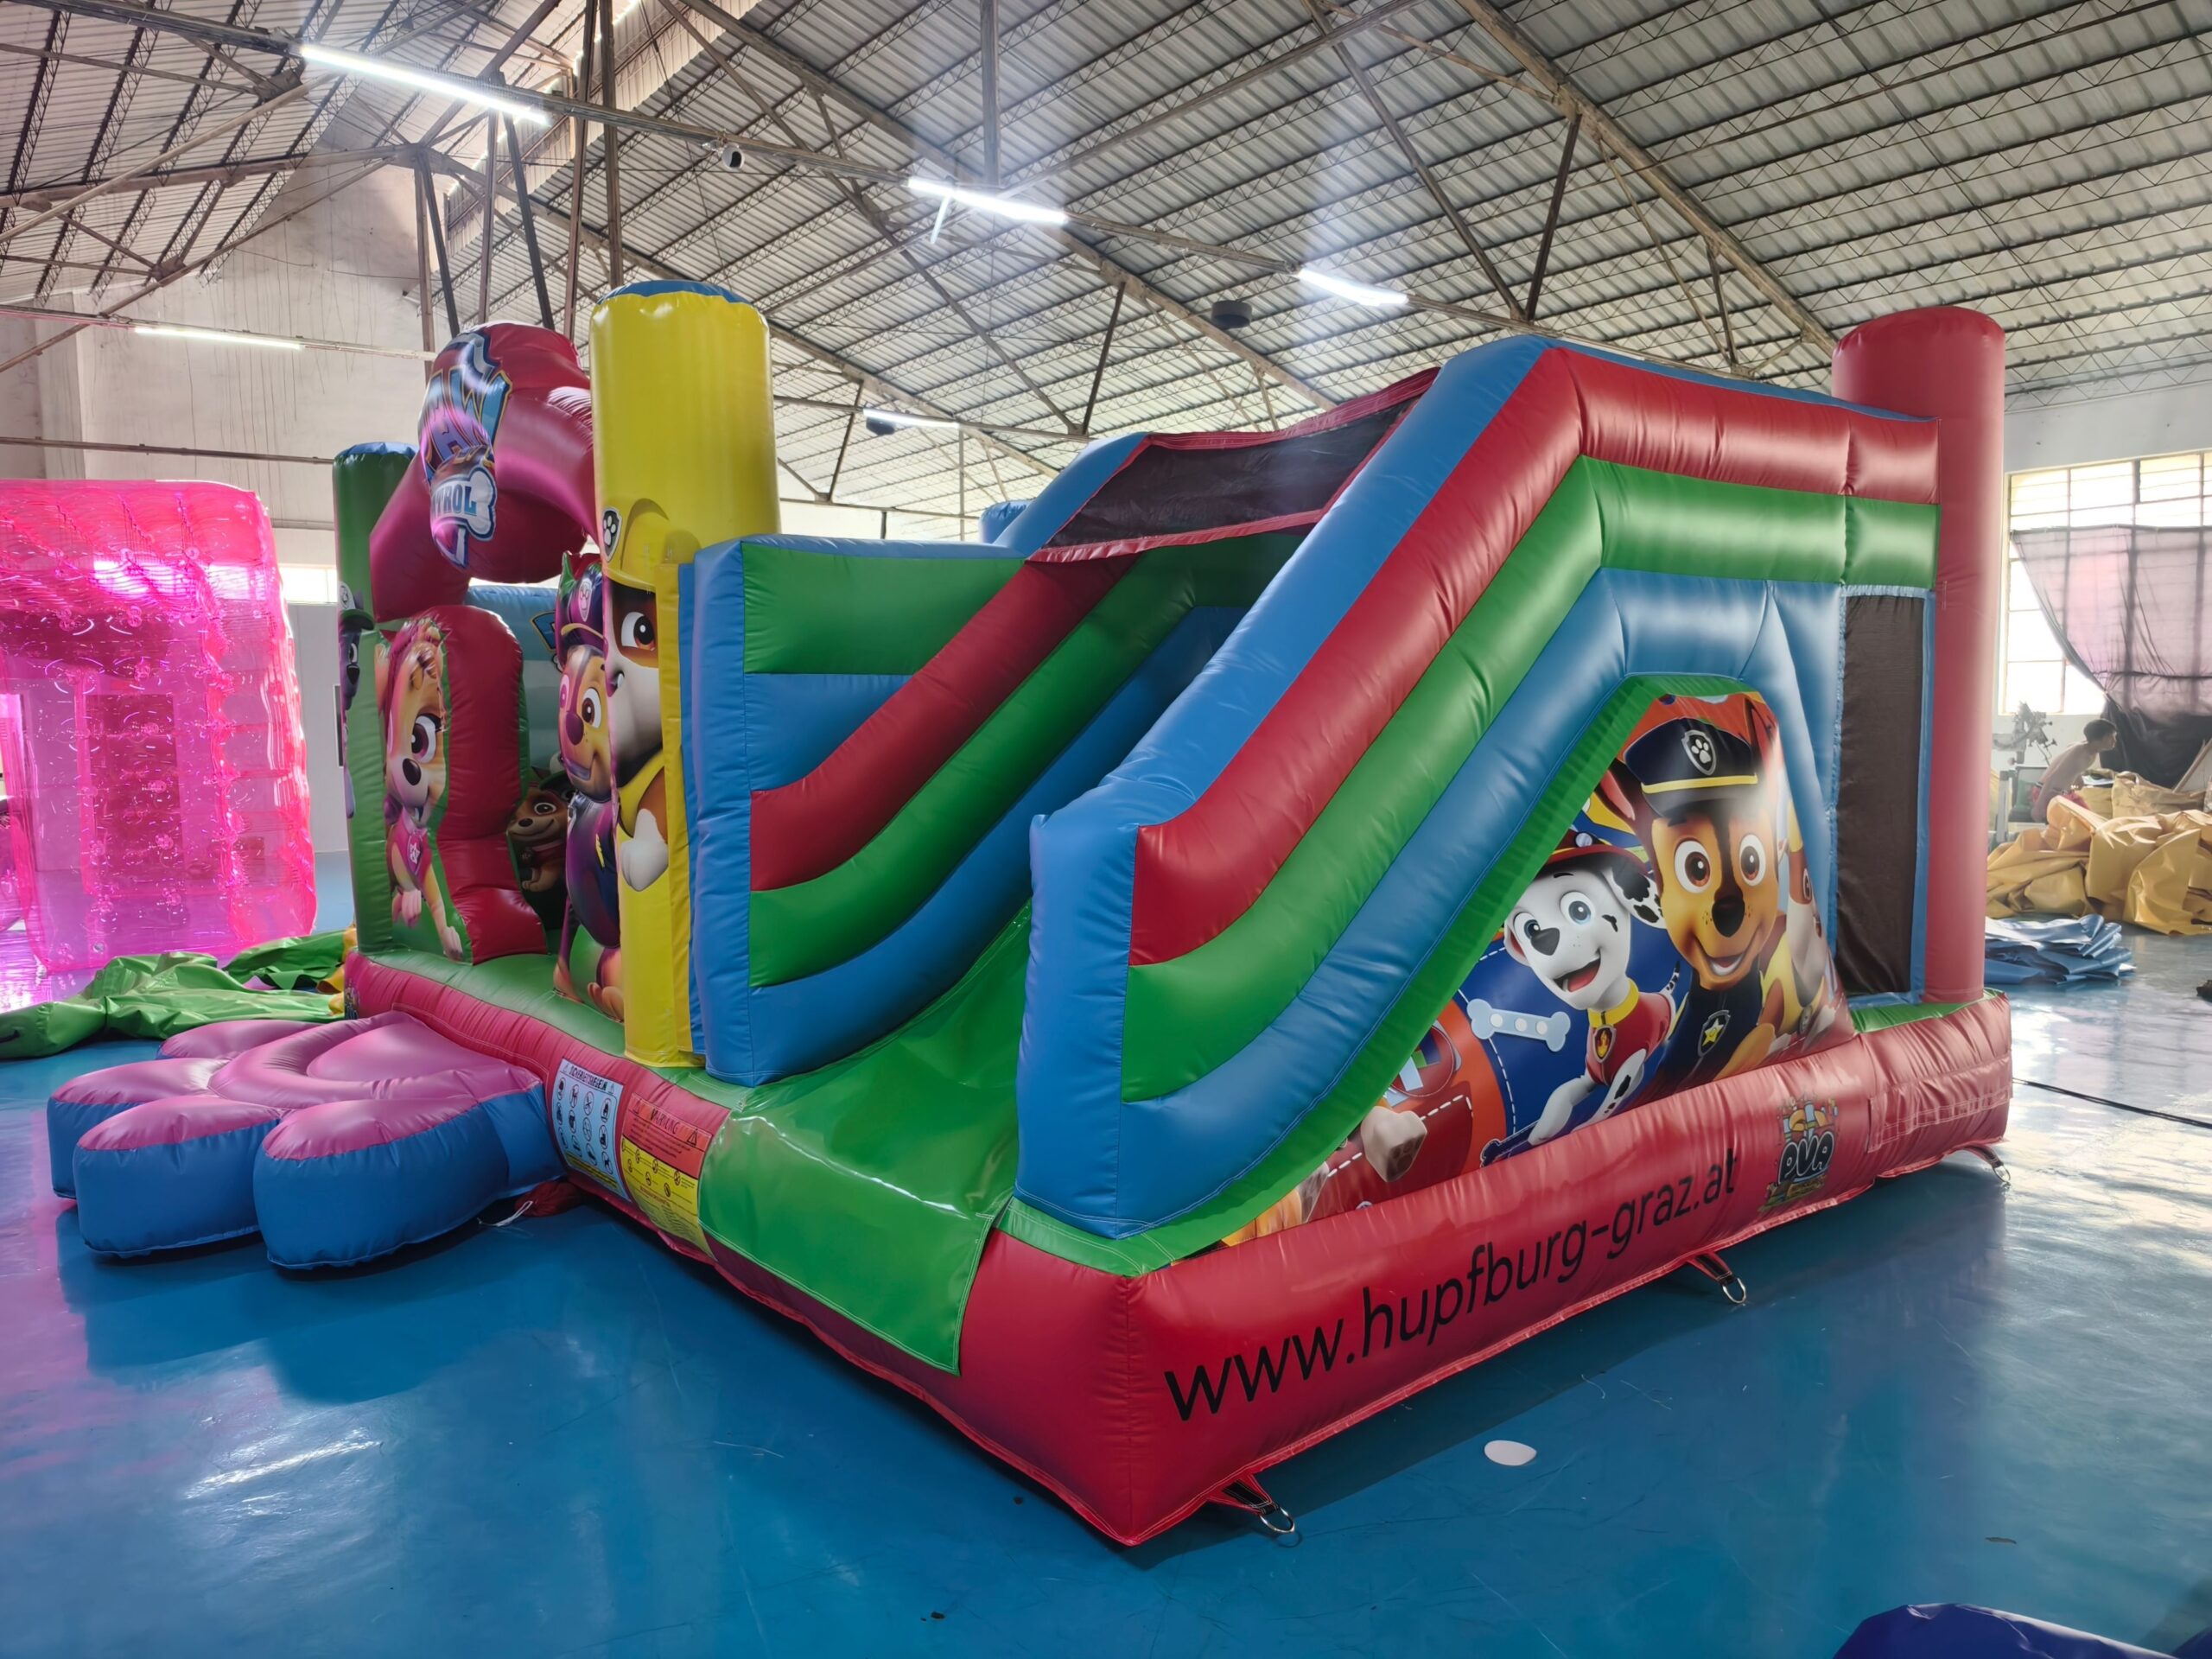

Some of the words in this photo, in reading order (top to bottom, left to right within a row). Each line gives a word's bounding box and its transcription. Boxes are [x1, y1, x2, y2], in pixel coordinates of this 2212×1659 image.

[418, 369, 512, 478] AW
[1777, 1130, 1835, 1186] PVA
[1164, 1147, 1738, 1422] www.hupfburg-graz.at
